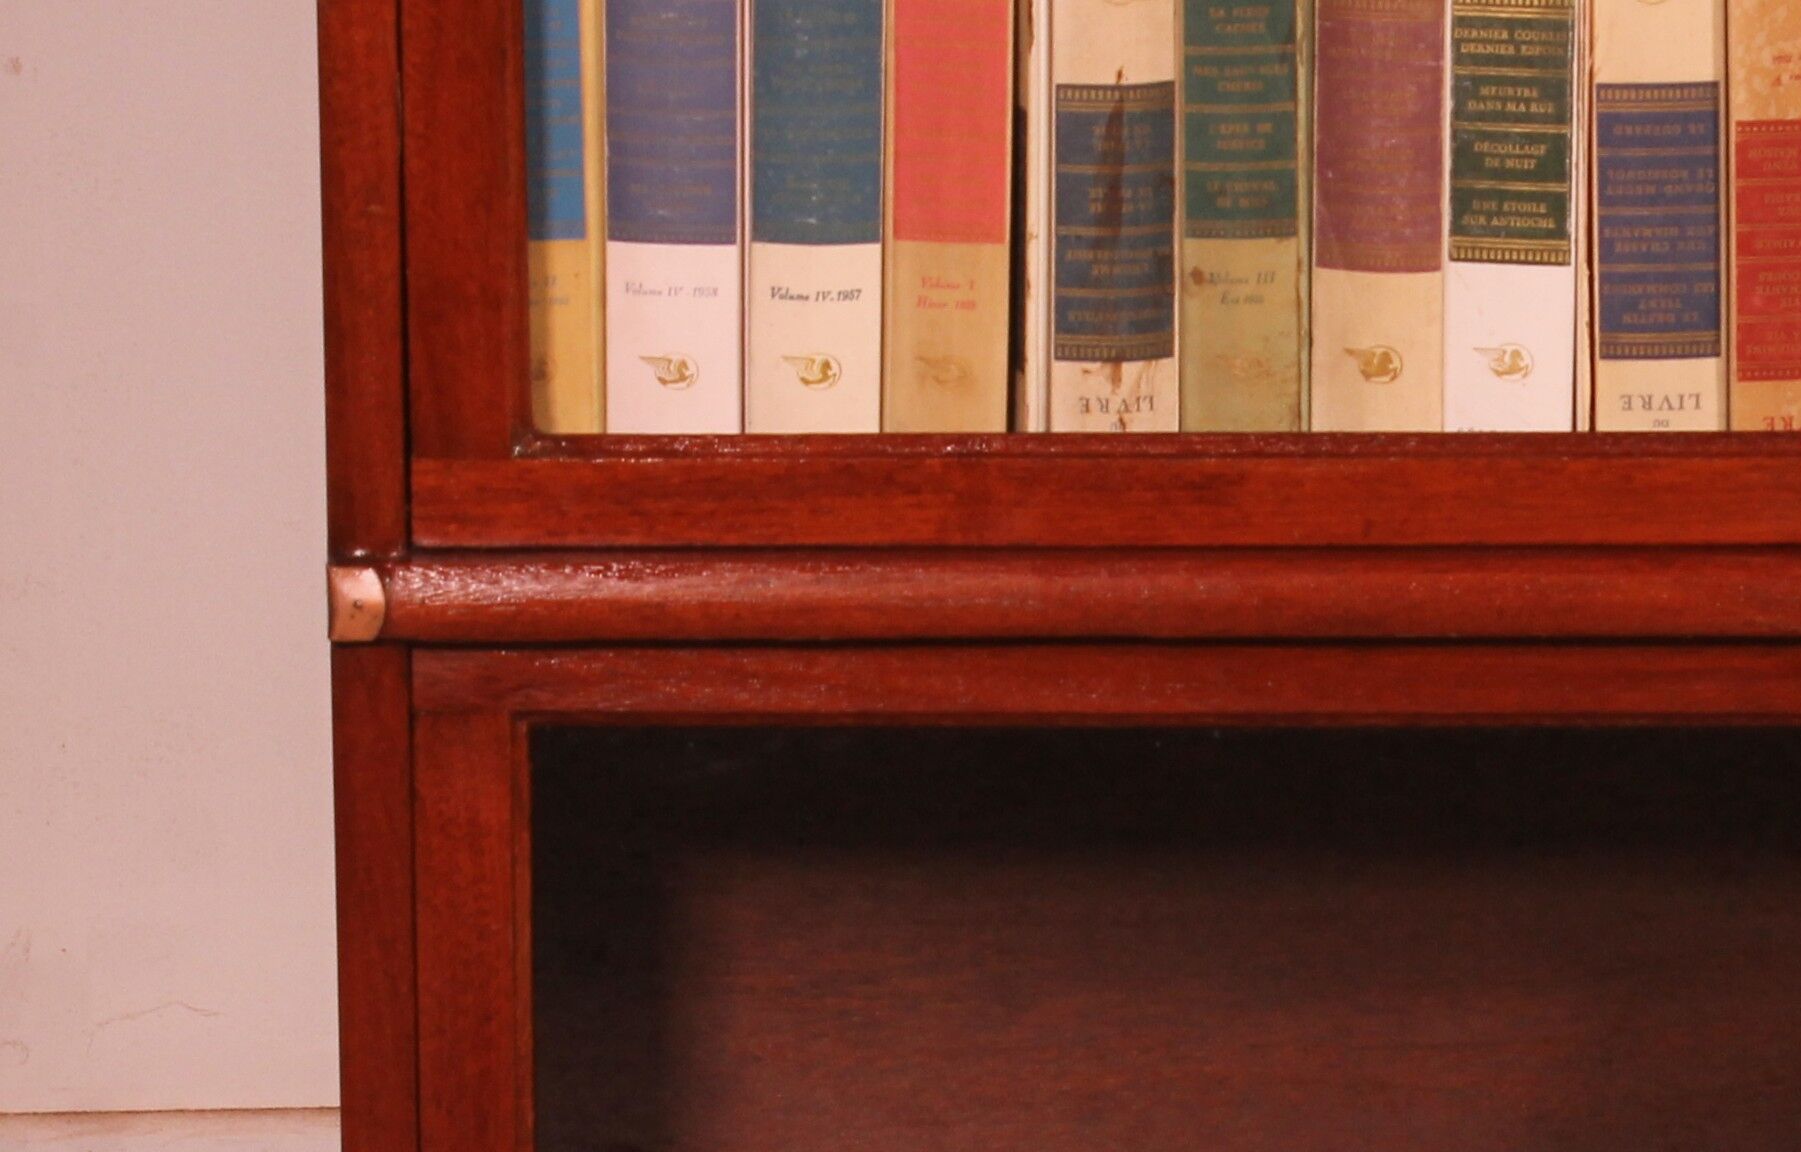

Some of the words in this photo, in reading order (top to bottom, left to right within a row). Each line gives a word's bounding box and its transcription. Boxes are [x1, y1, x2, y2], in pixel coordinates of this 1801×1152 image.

[1454, 26, 1509, 40] DERNIER
[1461, 42, 1515, 55] DERNIER
[1480, 85, 1538, 98] MEURTRE
[1468, 99, 1500, 111] DANS
[1504, 100, 1527, 112] MA
[1530, 101, 1554, 113] RUE
[1474, 140, 1547, 155] DÉCOLLAGE
[1485, 156, 1501, 168] DE
[1505, 157, 1537, 169] NUIT
[1462, 214, 1487, 227] SUR
[1491, 215, 1556, 229] ANTIOCHE
[1256, 270, 1276, 285] III
[667, 282, 684, 297] IV
[769, 285, 811, 301] Volume
[1081, 396, 1155, 415] LIVRE
[1620, 393, 1703, 412] LIVRE
[1653, 419, 1670, 429] DU
